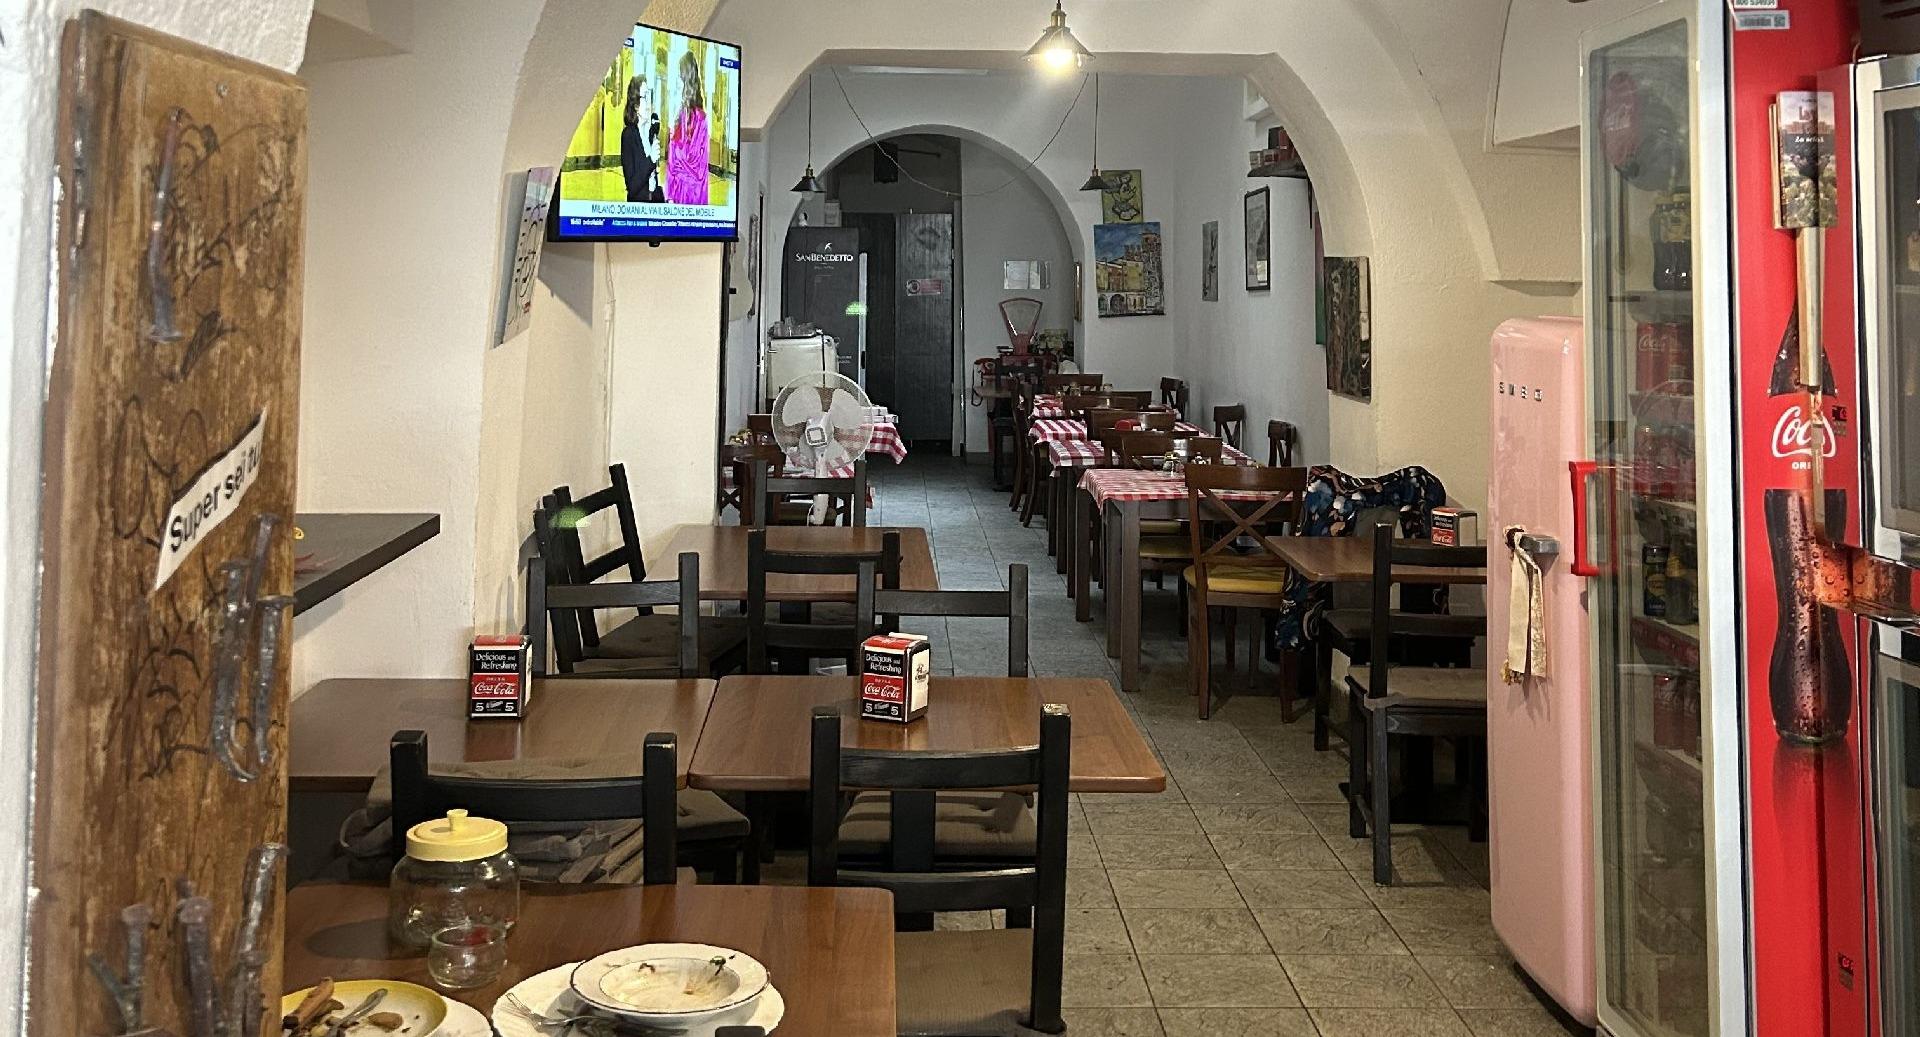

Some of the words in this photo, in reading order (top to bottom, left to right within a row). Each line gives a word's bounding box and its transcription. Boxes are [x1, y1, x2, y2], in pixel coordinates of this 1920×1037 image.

[170, 484, 221, 553] Super
[224, 450, 247, 500] sei
[475, 652, 506, 661] Delicious
[865, 653, 892, 663] Delicious
[481, 661, 517, 670] Refreshing
[870, 662, 902, 674] Refreshing
